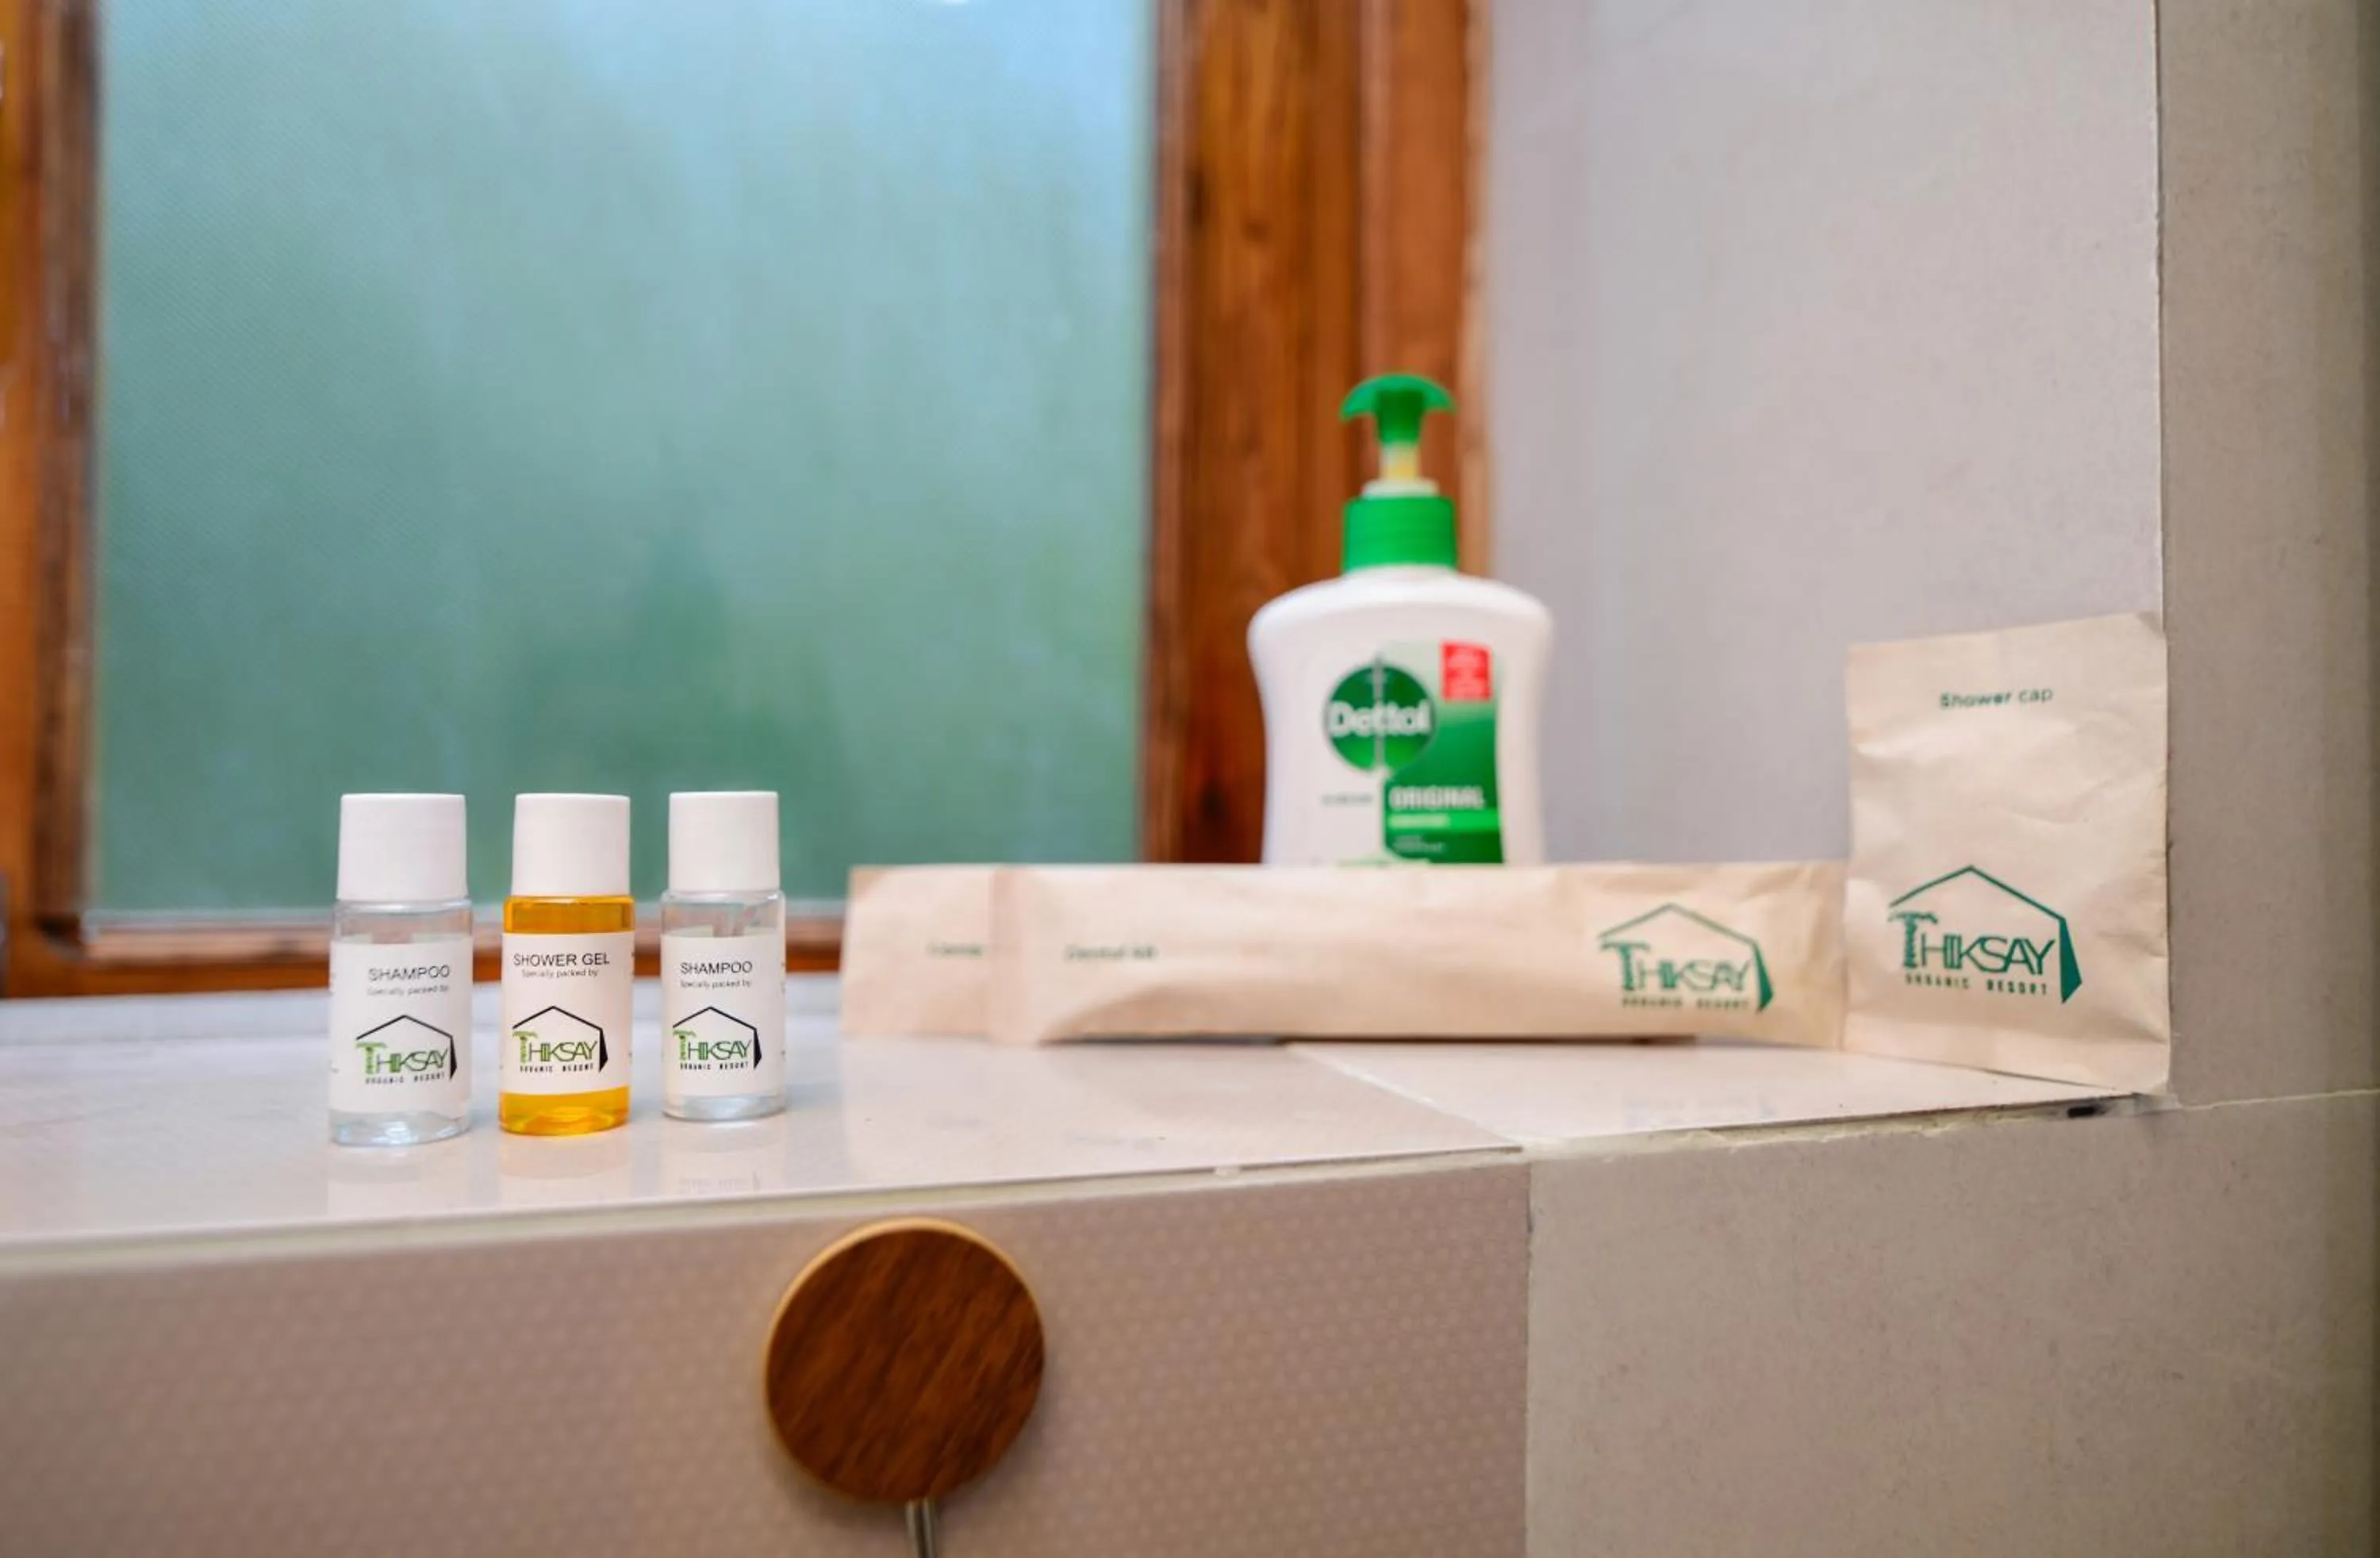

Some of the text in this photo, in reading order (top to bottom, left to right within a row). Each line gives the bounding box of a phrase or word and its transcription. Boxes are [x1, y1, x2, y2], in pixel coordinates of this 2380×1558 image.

[1940, 688, 2055, 710] Shower cap
[1328, 699, 1433, 739] Dettol
[1387, 786, 1486, 811] ORIGINAL
[513, 952, 610, 966] SHOWER GEL
[367, 965, 450, 981] SHAMPOO
[556, 968, 586, 977] packed
[680, 961, 753, 975] SHAMPOO
[1987, 979, 2048, 996] RESORT
